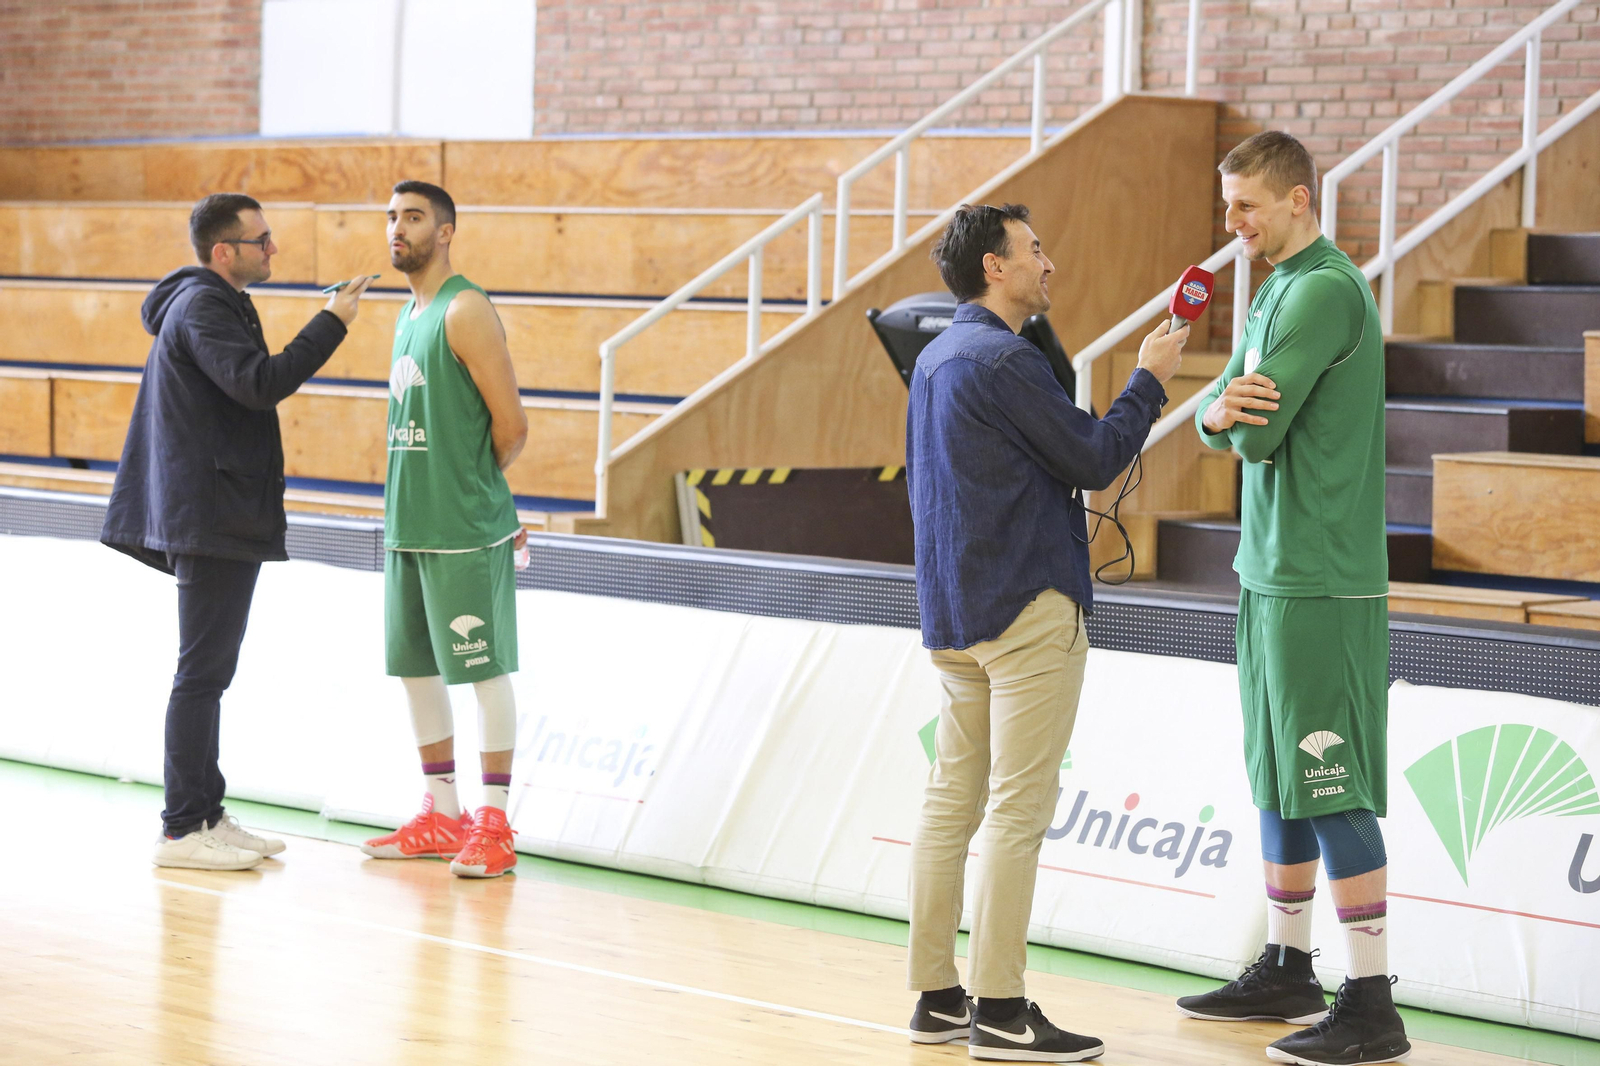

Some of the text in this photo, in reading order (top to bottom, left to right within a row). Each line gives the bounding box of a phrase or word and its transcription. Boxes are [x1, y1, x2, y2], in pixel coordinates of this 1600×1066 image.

[1185, 287, 1205, 300] MARCA
[1189, 282, 1205, 292] RADIO
[452, 638, 487, 652] Unicaja
[1305, 763, 1346, 778] Unicaja
[1045, 787, 1233, 878] Unicaja
